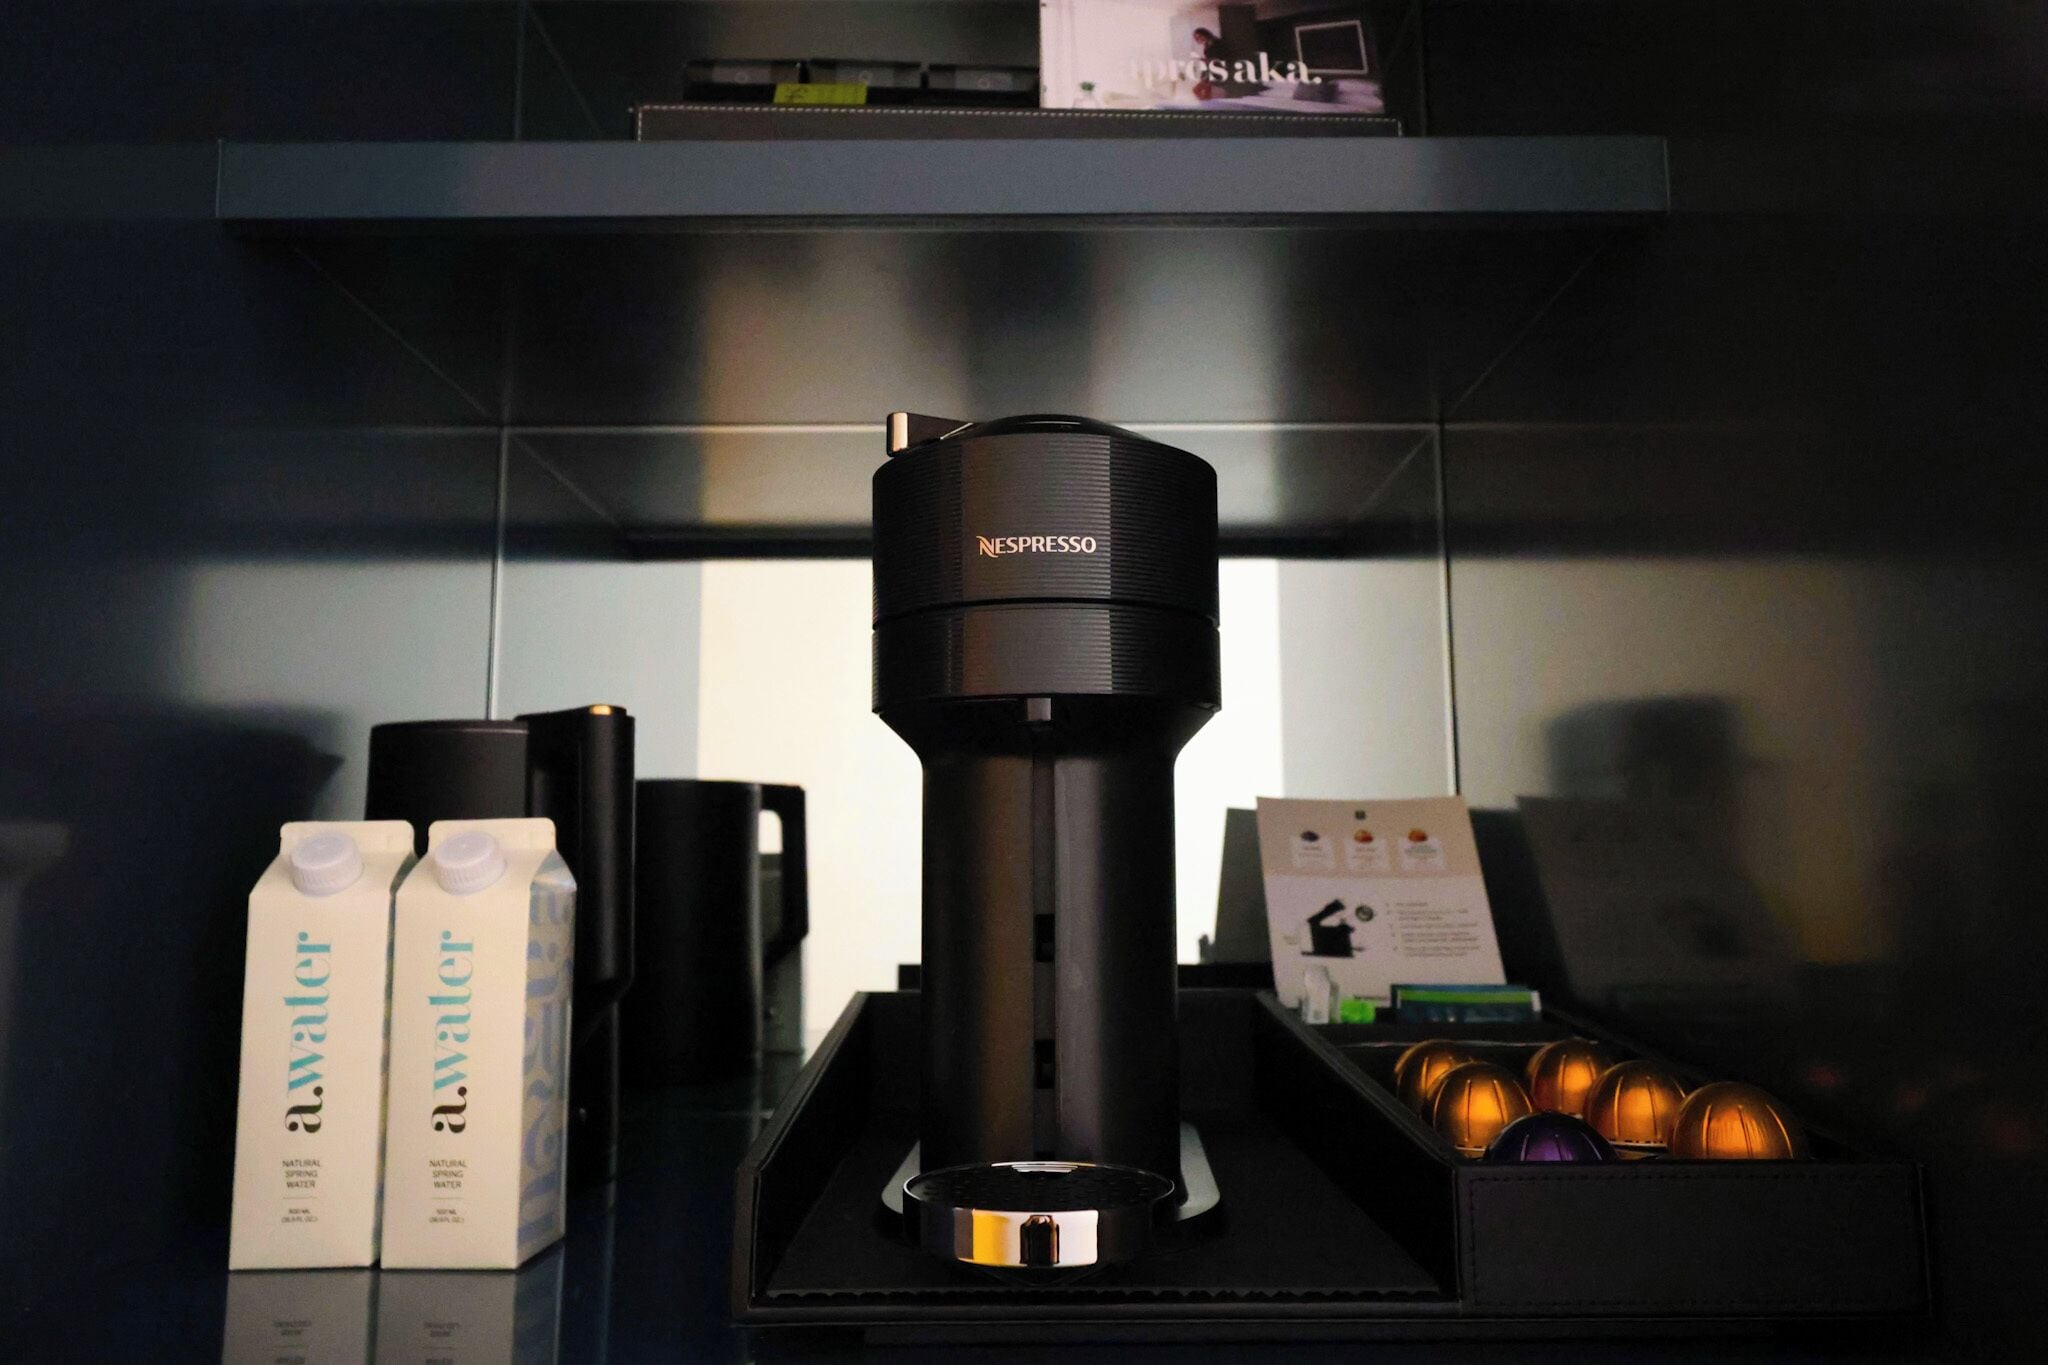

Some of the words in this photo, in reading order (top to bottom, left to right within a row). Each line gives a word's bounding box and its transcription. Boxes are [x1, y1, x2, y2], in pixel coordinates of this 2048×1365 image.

[1122, 52, 1228, 89] près
[1233, 52, 1322, 84] aka.
[976, 535, 1096, 558] NESPRESSO
[283, 931, 331, 1133] a.water
[427, 930, 474, 1133] a.water
[282, 1160, 321, 1168] NATURAL
[429, 1160, 467, 1168] NATURAL
[285, 1170, 318, 1178] SPRING
[432, 1170, 464, 1178] SPRING
[286, 1180, 316, 1188] WATER
[433, 1180, 462, 1188] WATER
